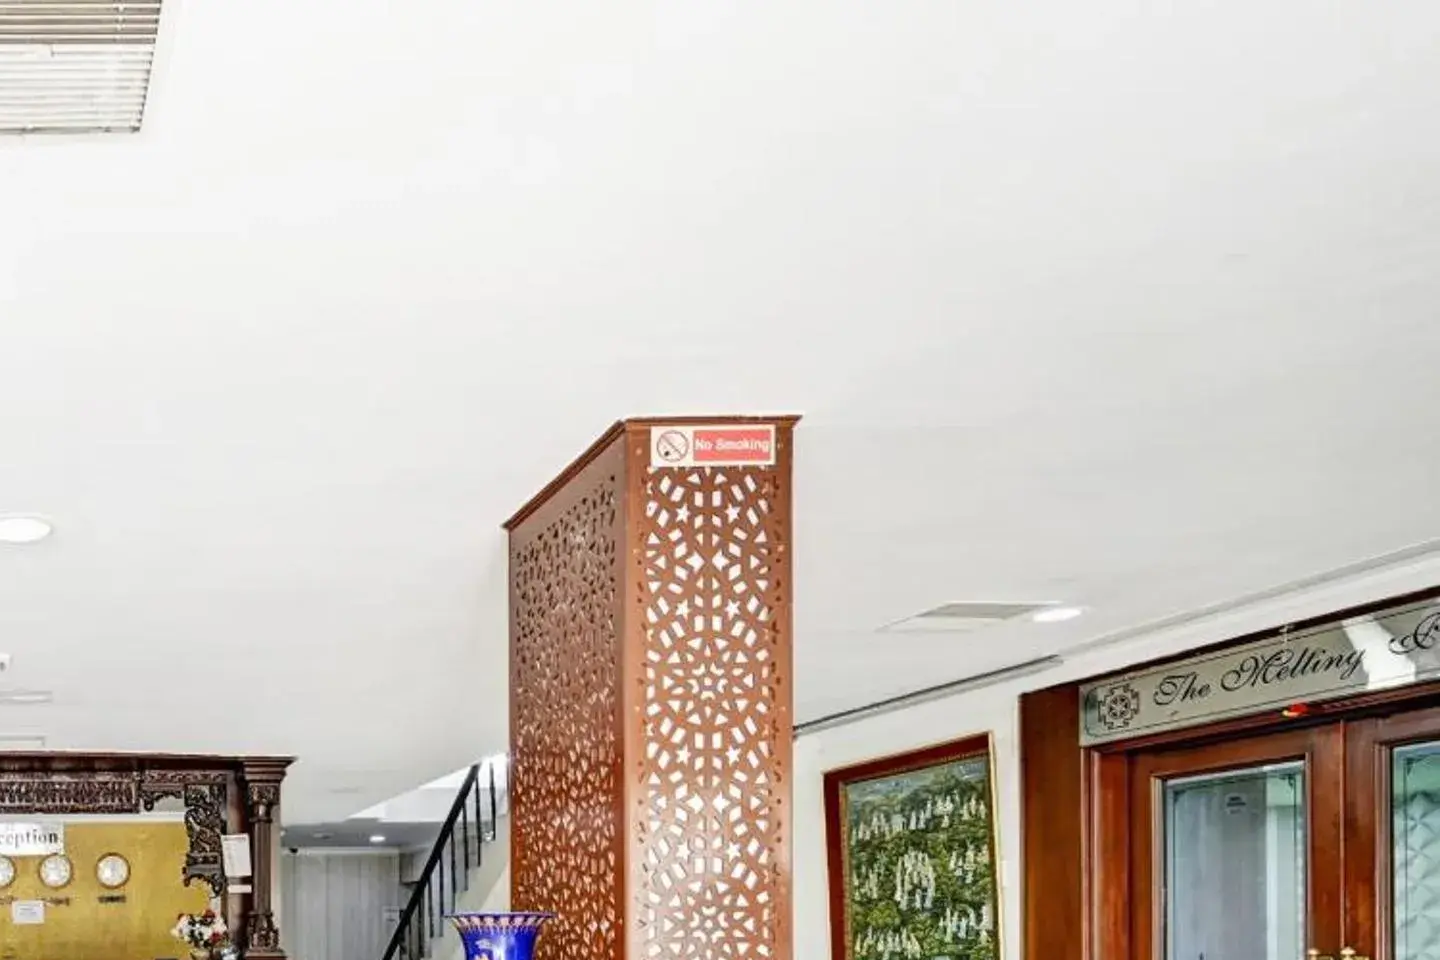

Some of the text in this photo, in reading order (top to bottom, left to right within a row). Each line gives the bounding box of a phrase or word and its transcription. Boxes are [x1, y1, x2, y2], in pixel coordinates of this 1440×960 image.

[695, 438, 769, 453] No Smoking
[1153, 671, 1211, 706] The
